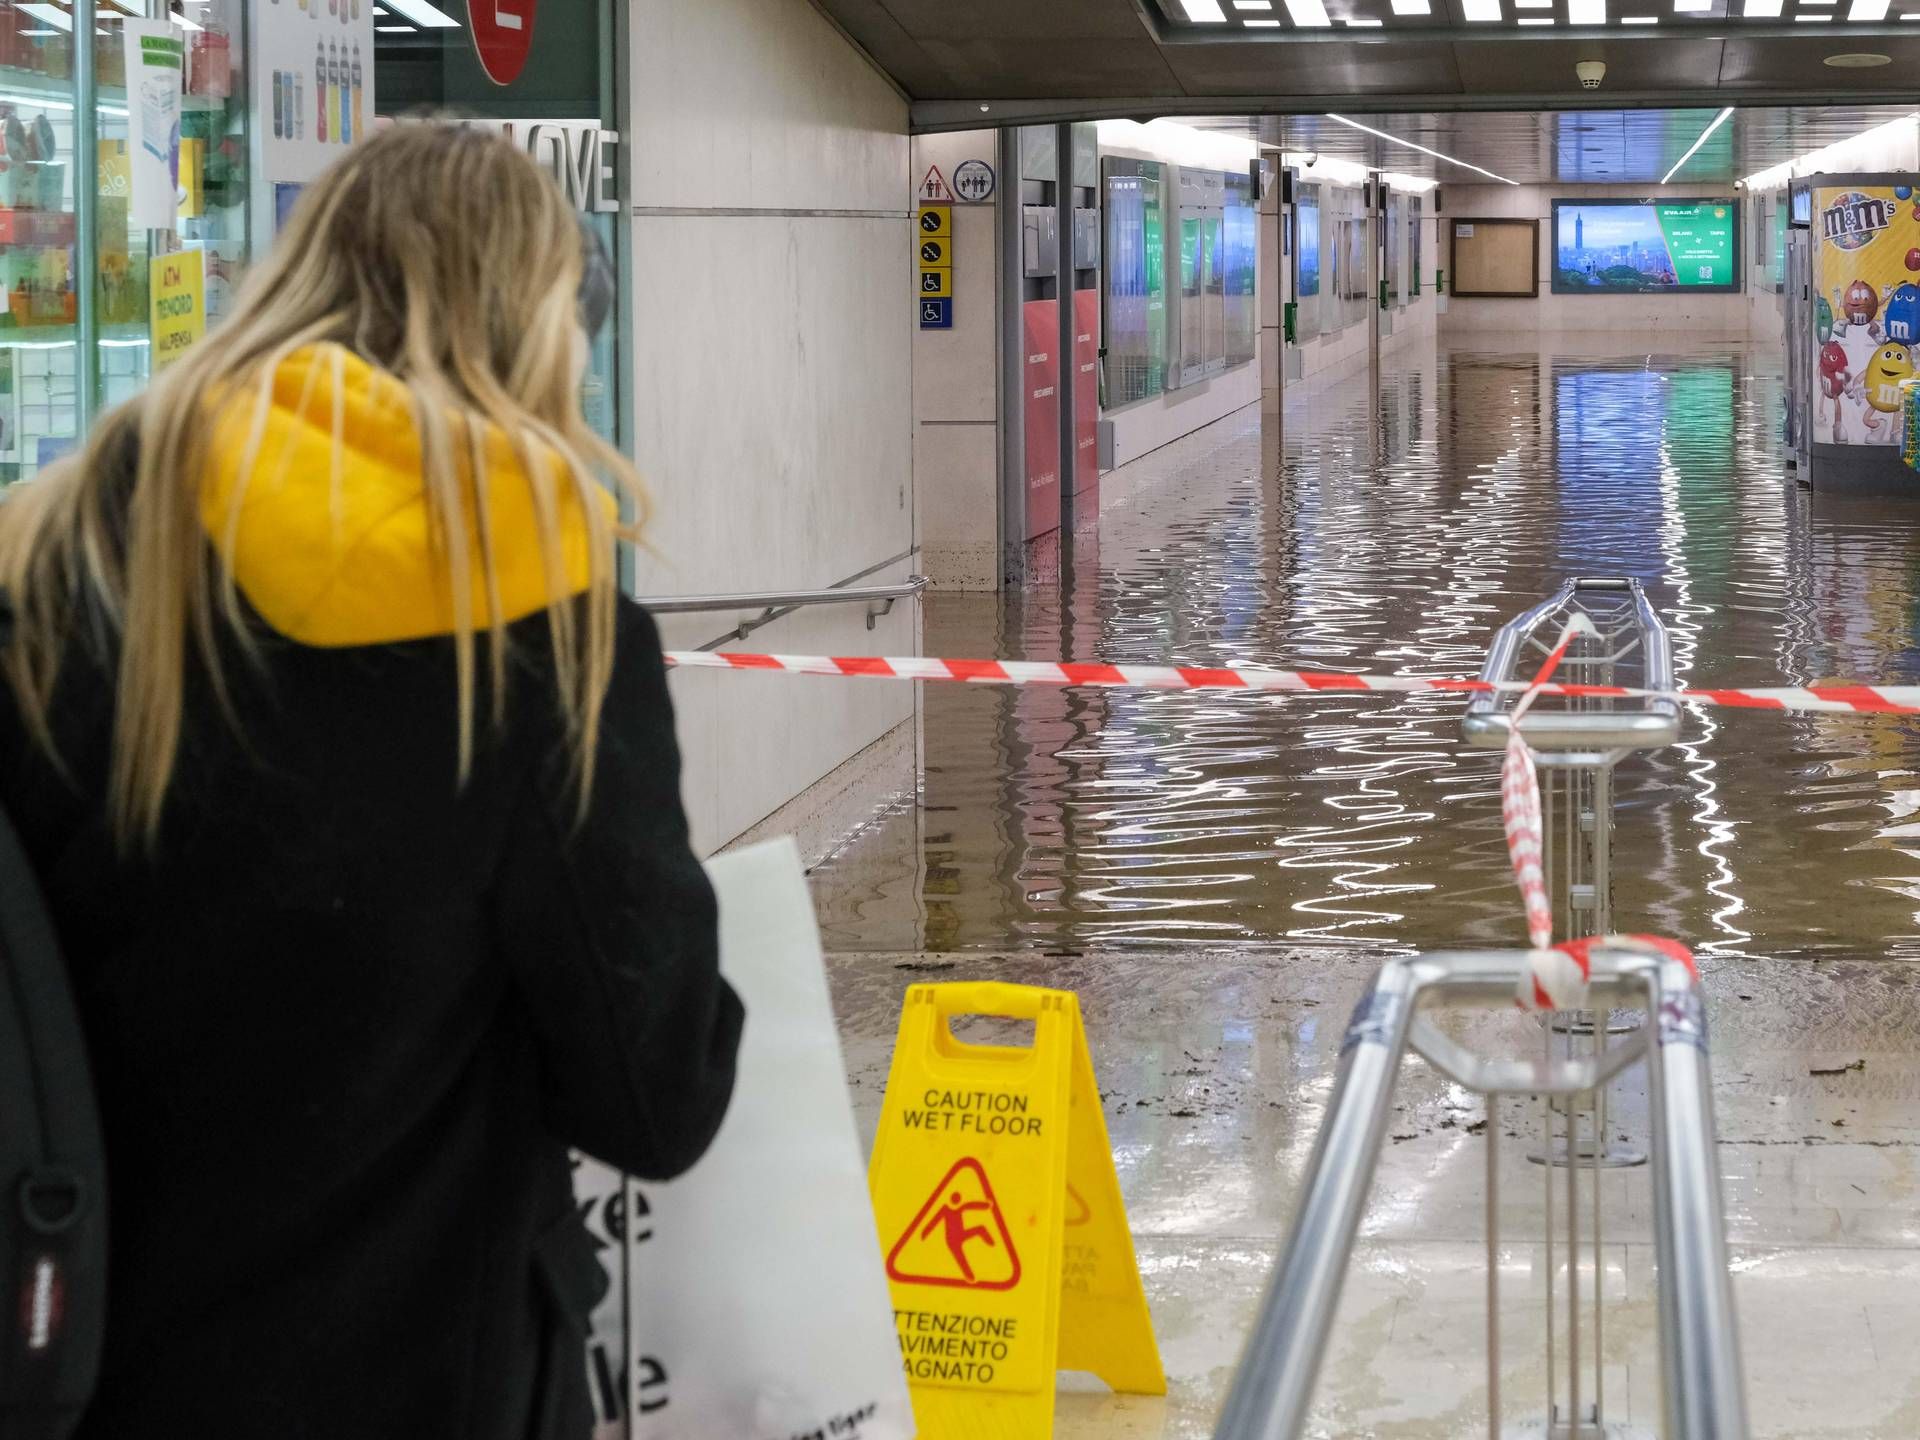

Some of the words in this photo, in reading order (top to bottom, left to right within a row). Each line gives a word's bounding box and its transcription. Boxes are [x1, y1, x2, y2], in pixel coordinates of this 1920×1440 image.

[502, 123, 620, 213] OVE
[924, 1089, 1029, 1113] CAUTION
[903, 1110, 955, 1131] WET
[960, 1114, 1043, 1137] FLOOR
